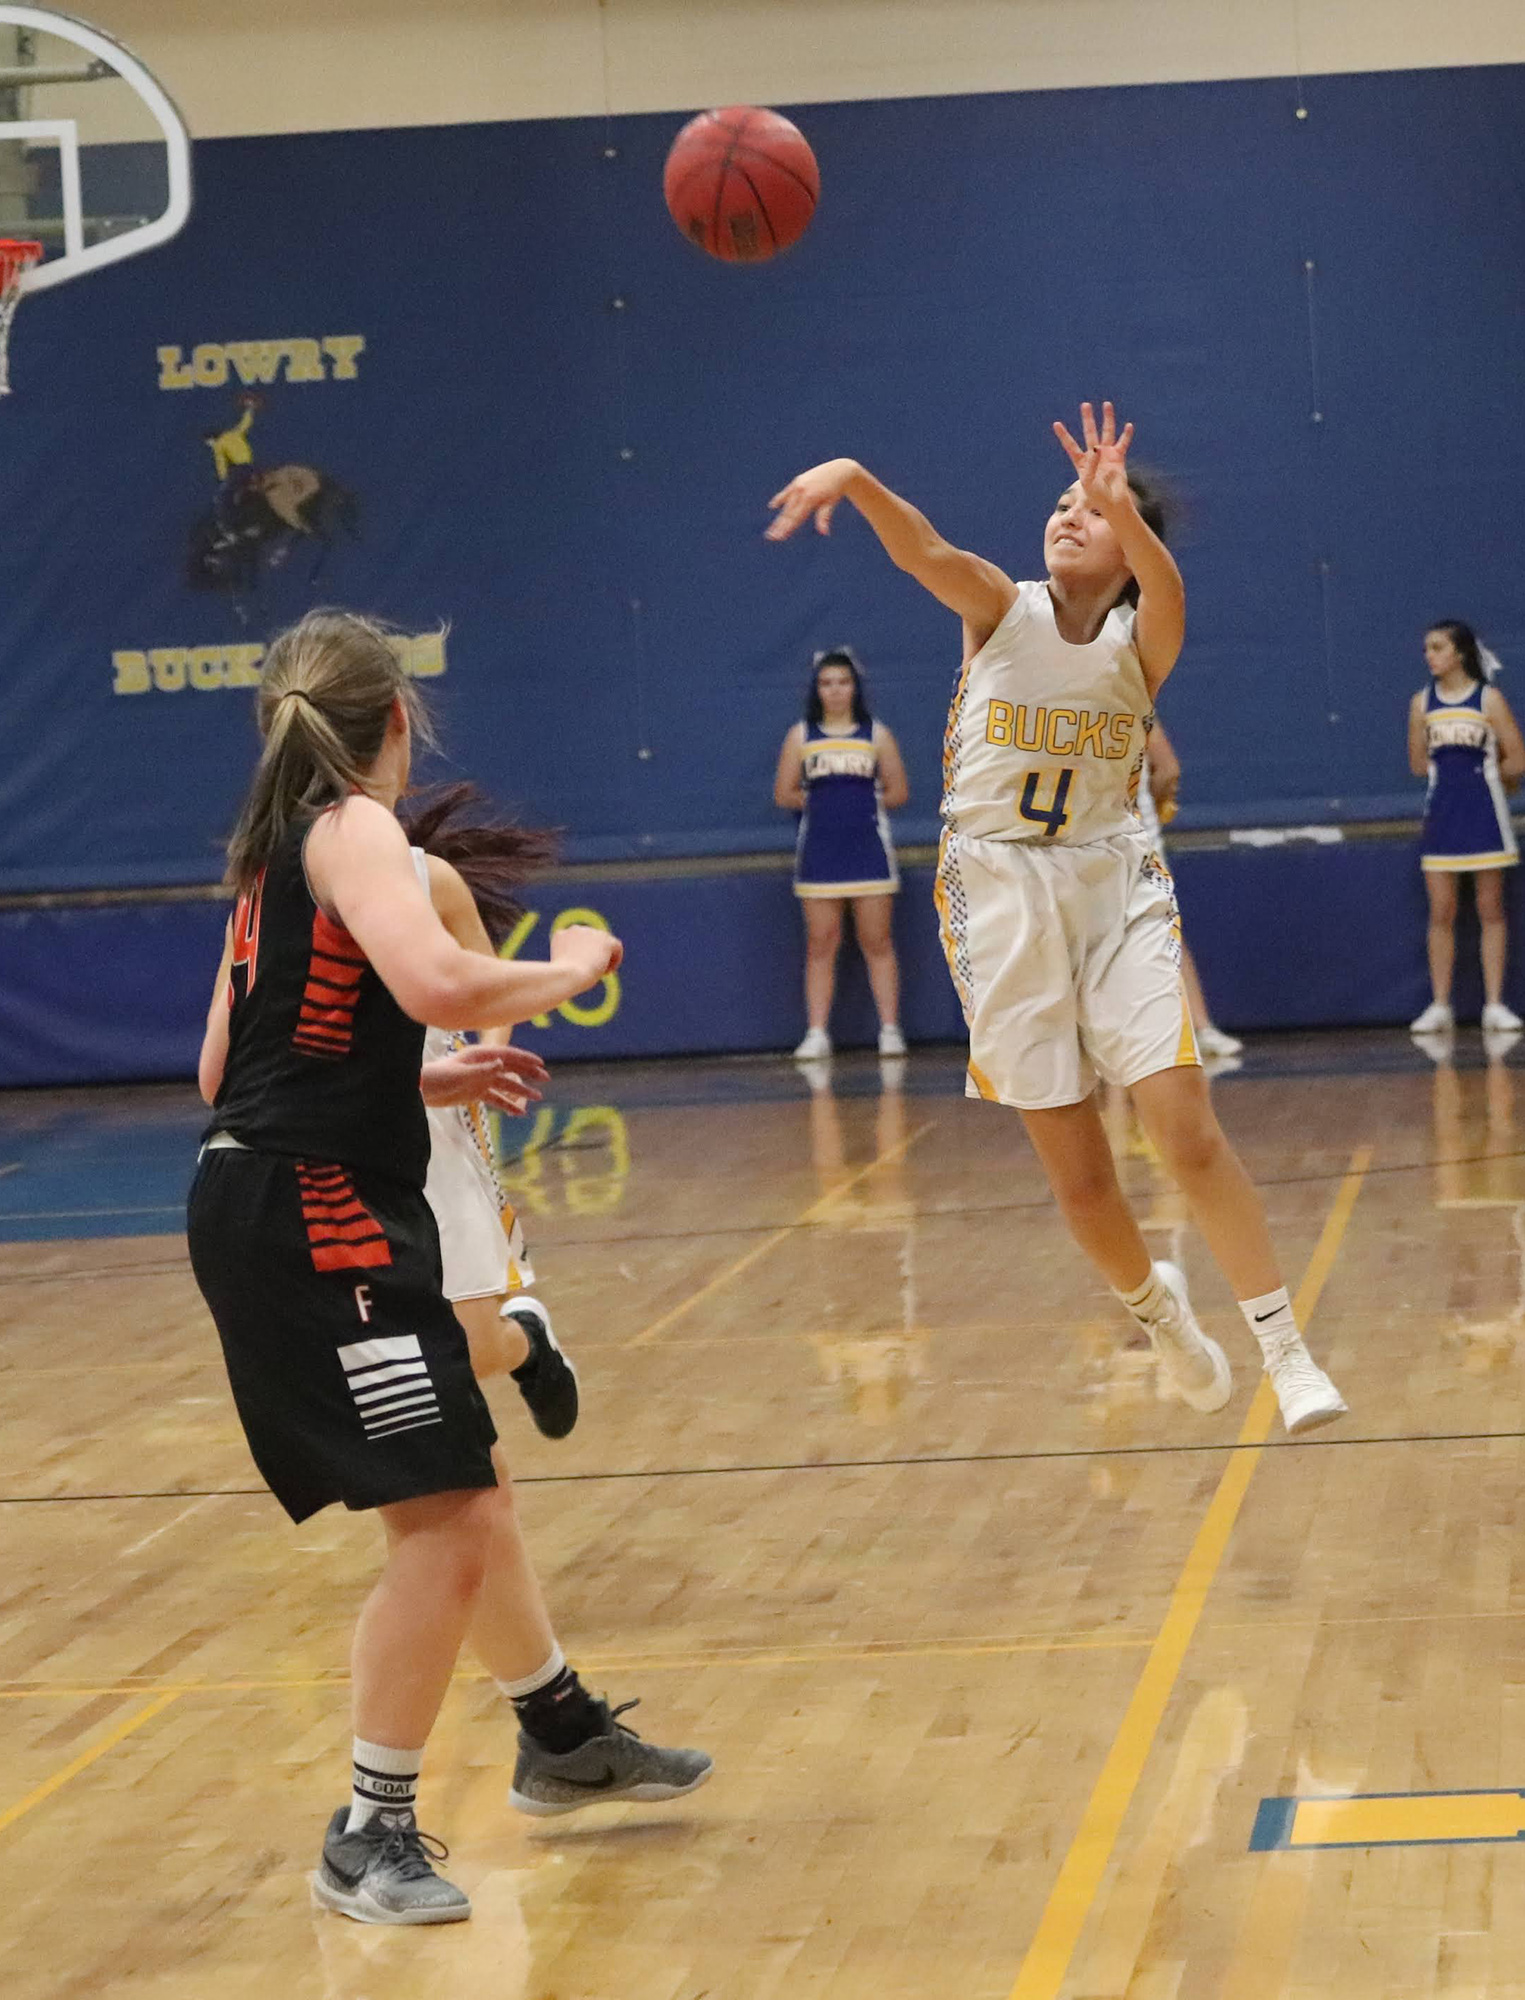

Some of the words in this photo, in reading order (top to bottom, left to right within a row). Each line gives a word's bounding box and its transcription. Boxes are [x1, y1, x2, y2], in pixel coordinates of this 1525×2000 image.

[157, 335, 365, 390] LOWRY
[986, 698, 1135, 760] BUCKS
[1018, 767, 1076, 837] 4
[354, 1284, 373, 1323] F
[373, 1781, 412, 1795] GOAT
